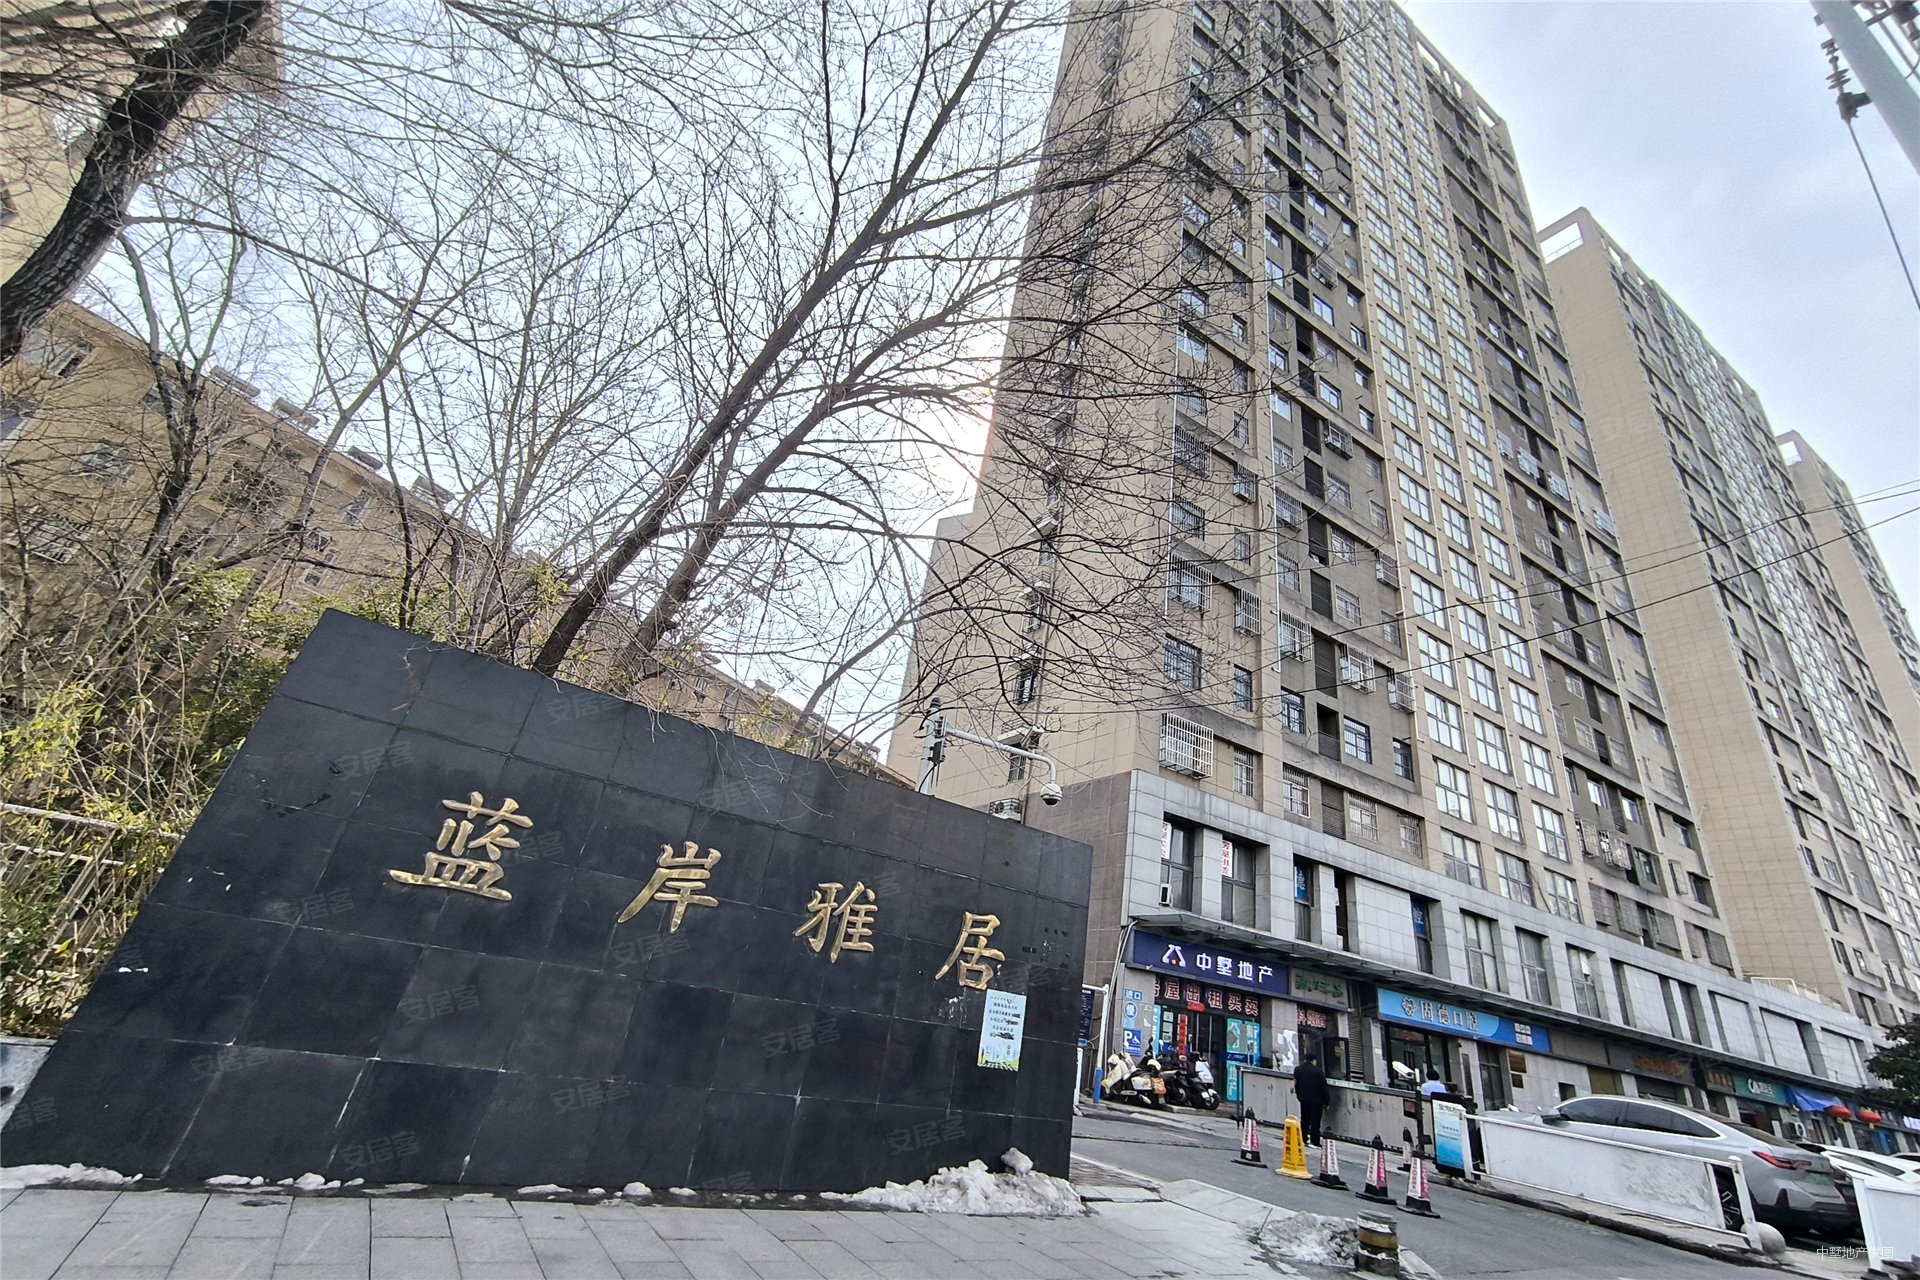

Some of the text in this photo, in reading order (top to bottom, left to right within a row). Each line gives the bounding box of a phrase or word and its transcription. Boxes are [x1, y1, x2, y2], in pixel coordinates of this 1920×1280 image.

[389, 791, 1005, 990] 蓝岸雅居
[1195, 952, 1274, 984] 中墅地产
